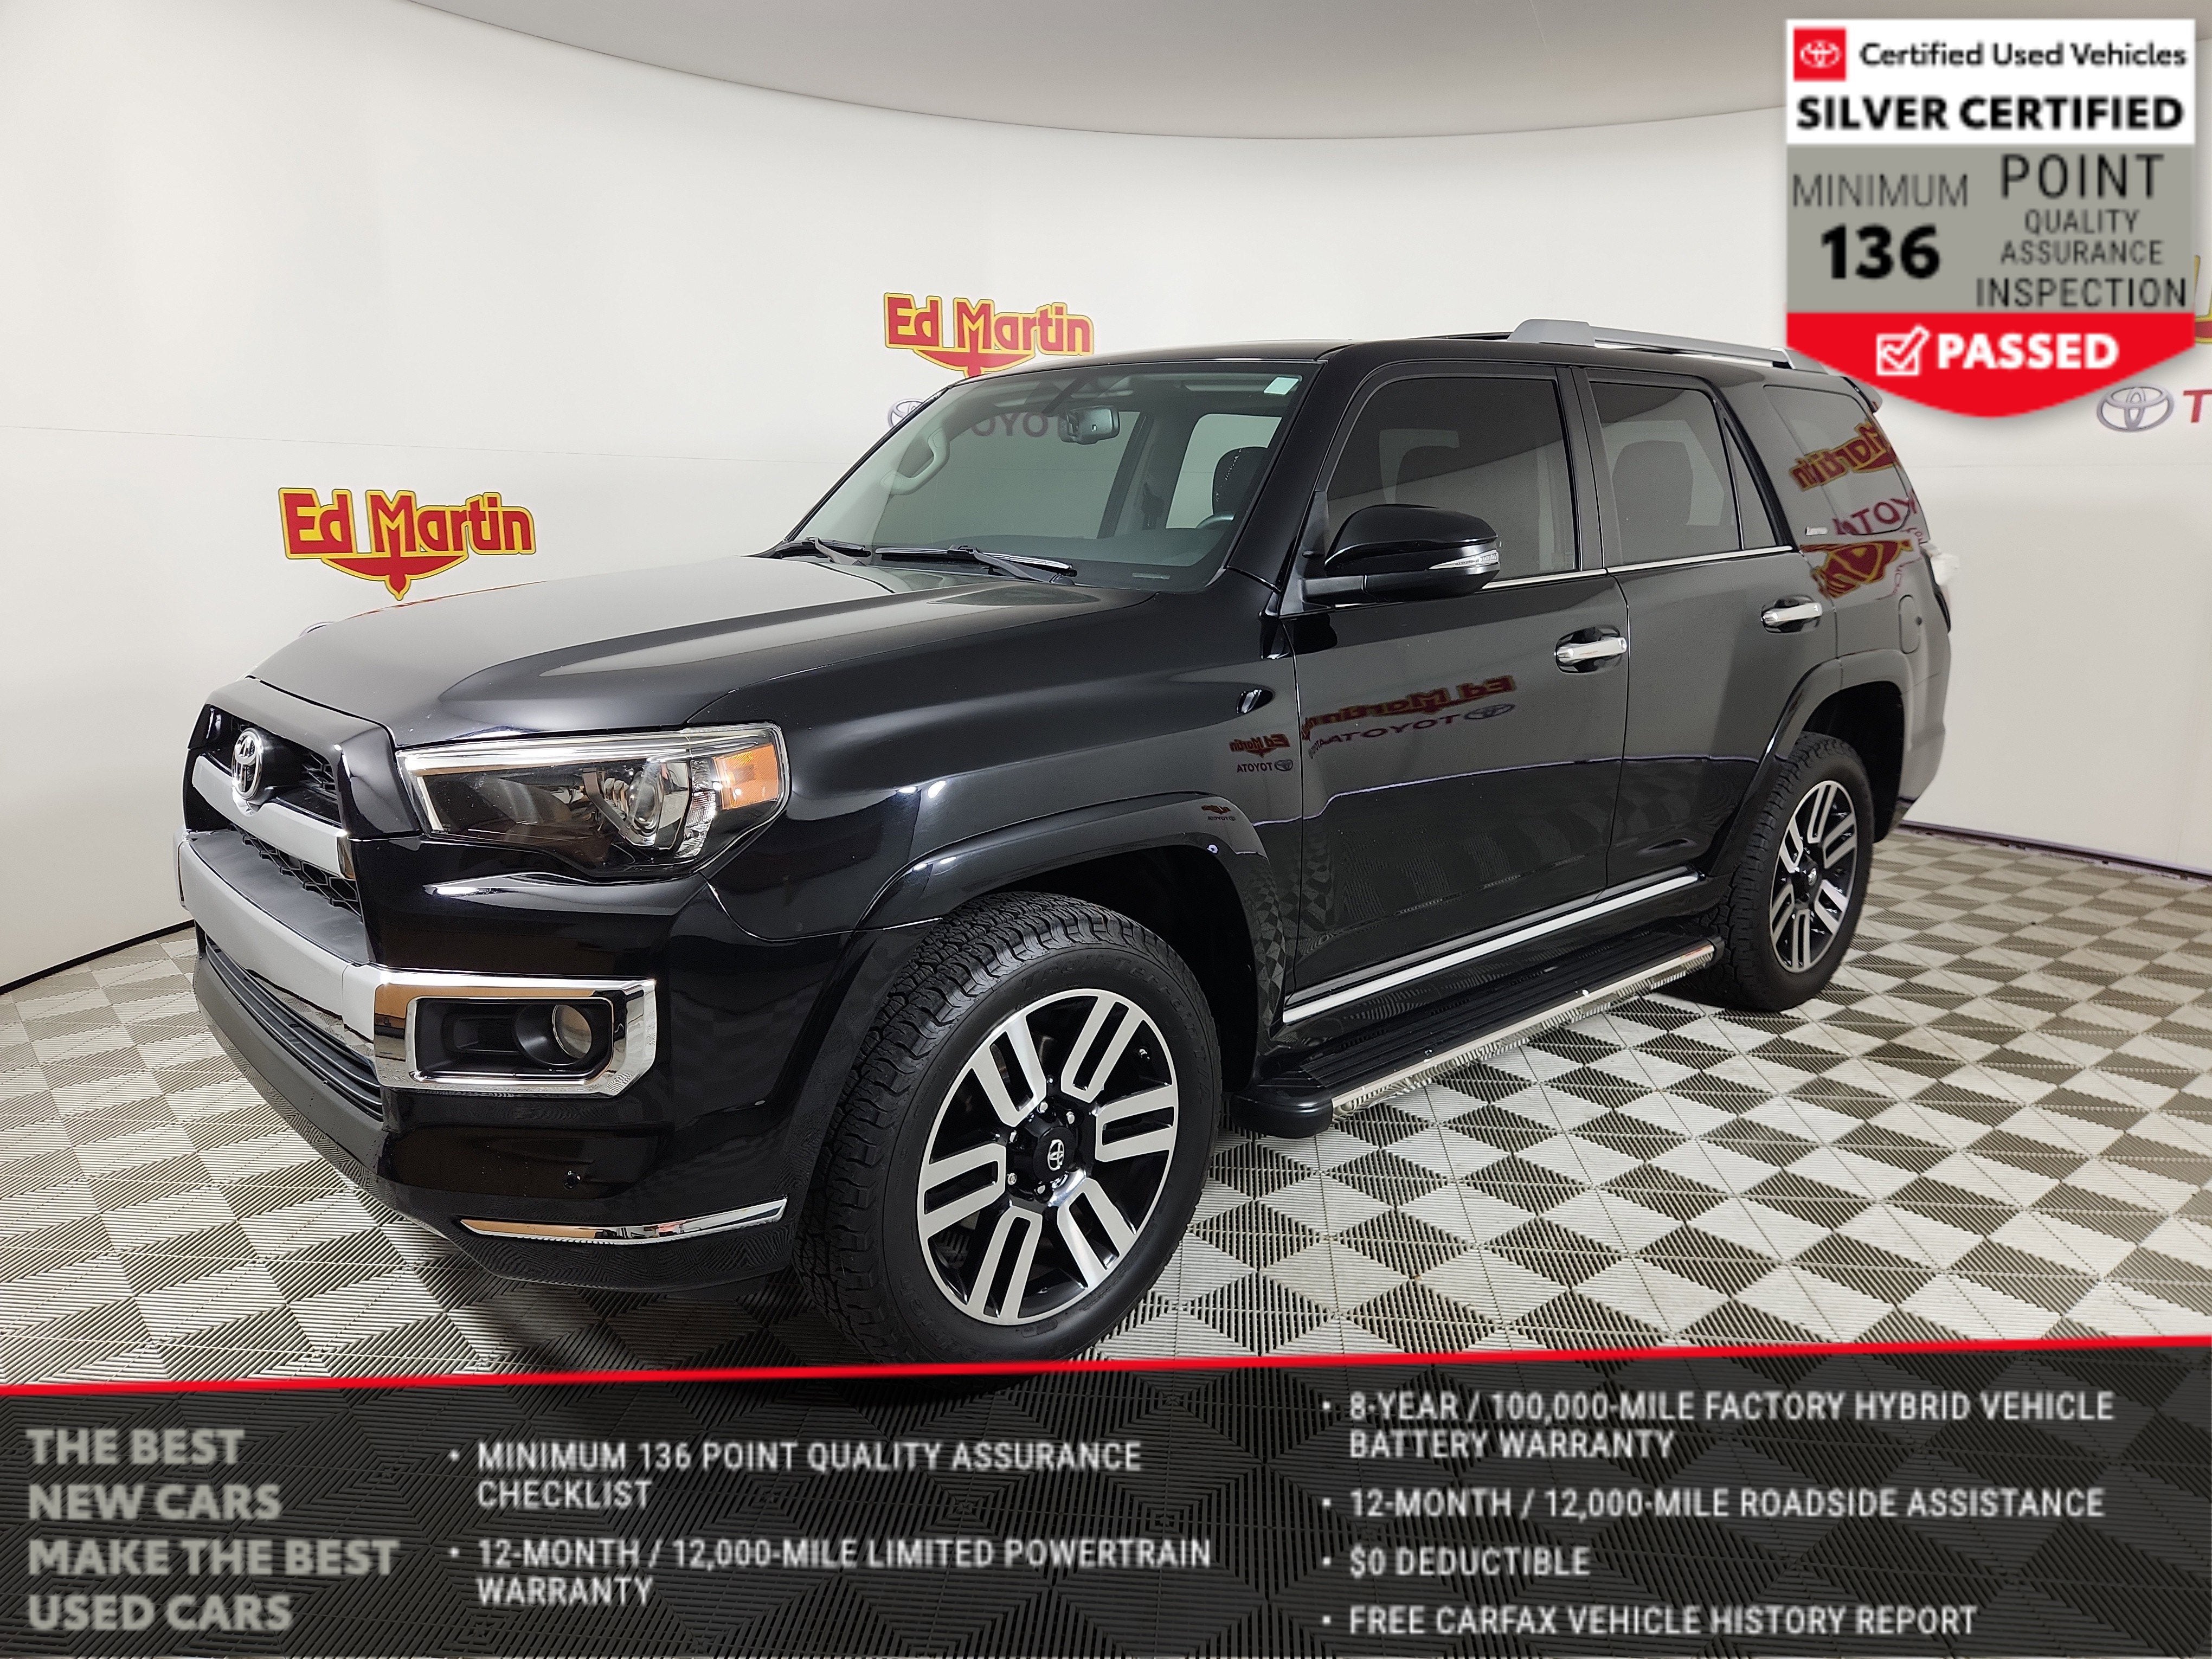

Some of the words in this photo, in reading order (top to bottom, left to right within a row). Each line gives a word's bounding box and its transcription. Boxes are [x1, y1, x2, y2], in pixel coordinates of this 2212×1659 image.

[885, 294, 941, 348] Ed
[955, 299, 1094, 355] Martin
[280, 490, 355, 557] Ed
[367, 491, 535, 554] Martin
